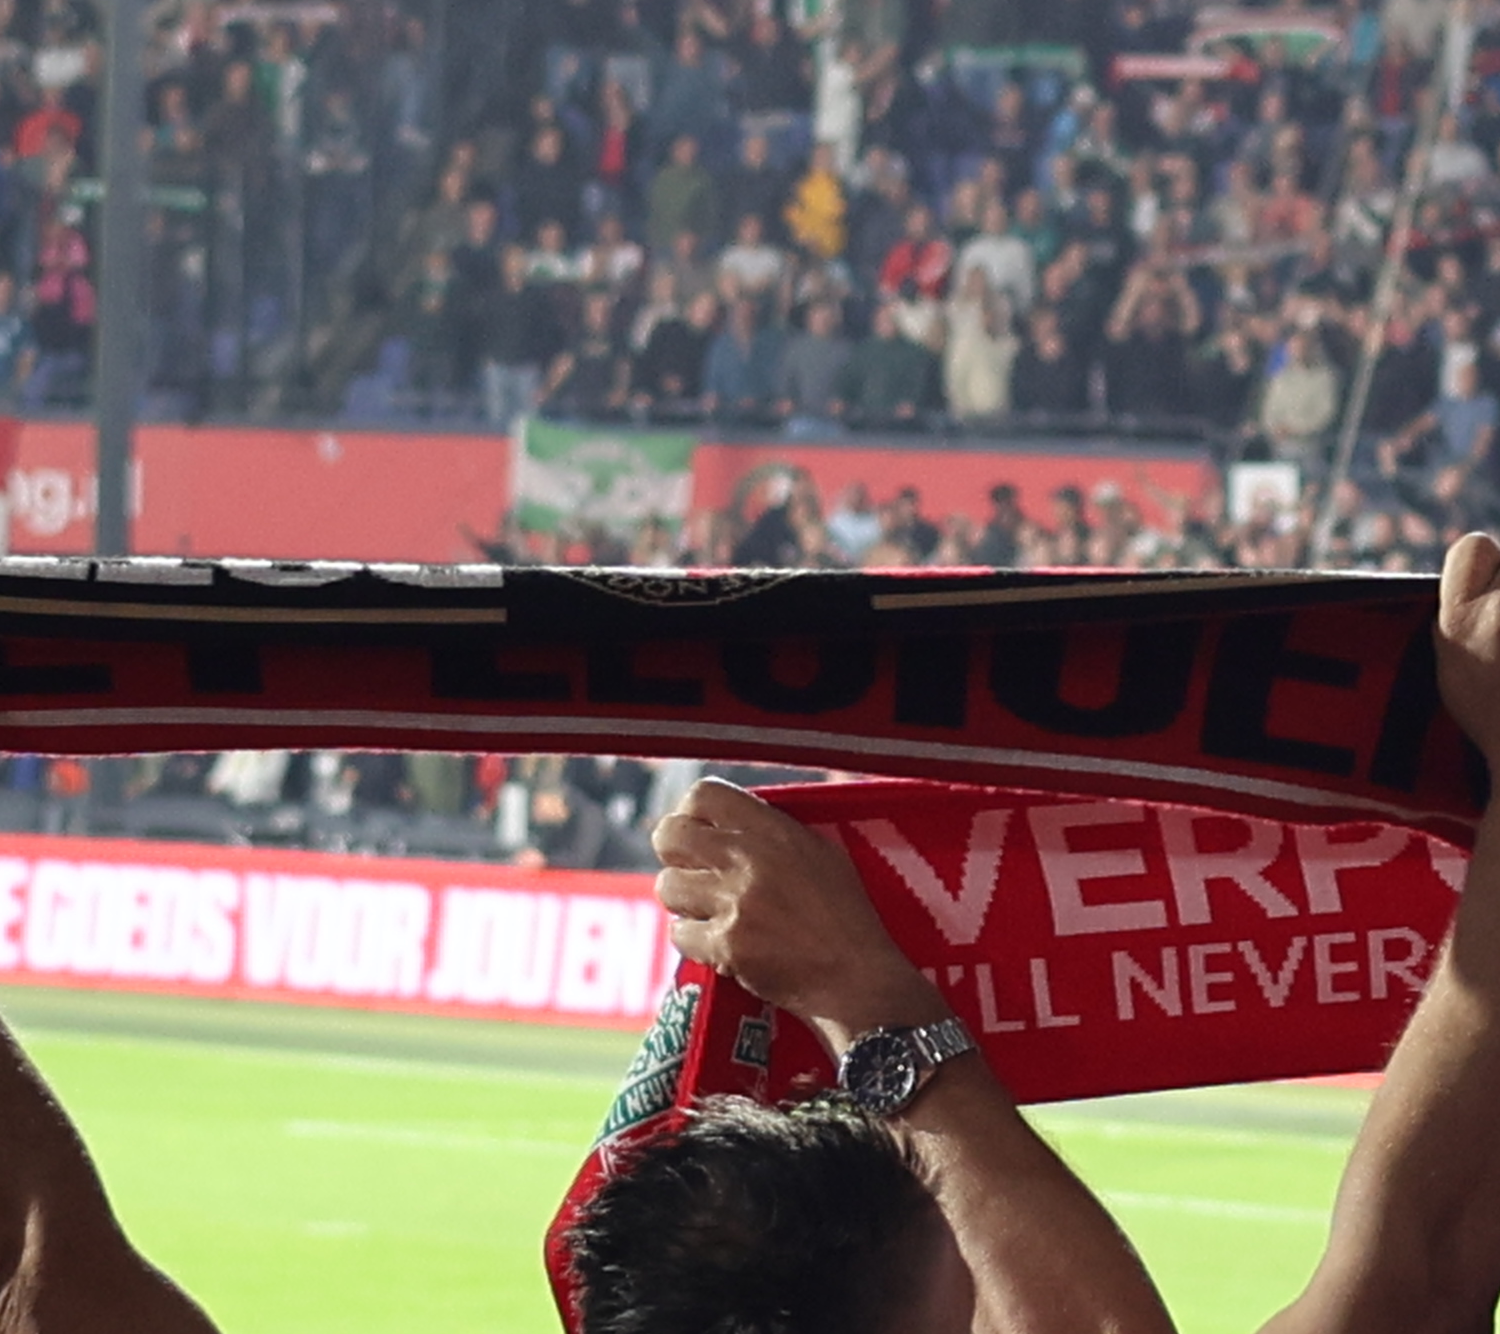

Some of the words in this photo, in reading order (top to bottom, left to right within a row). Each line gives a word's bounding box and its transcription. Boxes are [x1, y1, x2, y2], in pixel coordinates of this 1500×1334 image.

[23, 859, 240, 981] GOEDS
[243, 872, 432, 997] VOOR
[427, 883, 562, 1009] JOU
[557, 894, 658, 1017] EN
[1111, 925, 1435, 1023] NEVER
